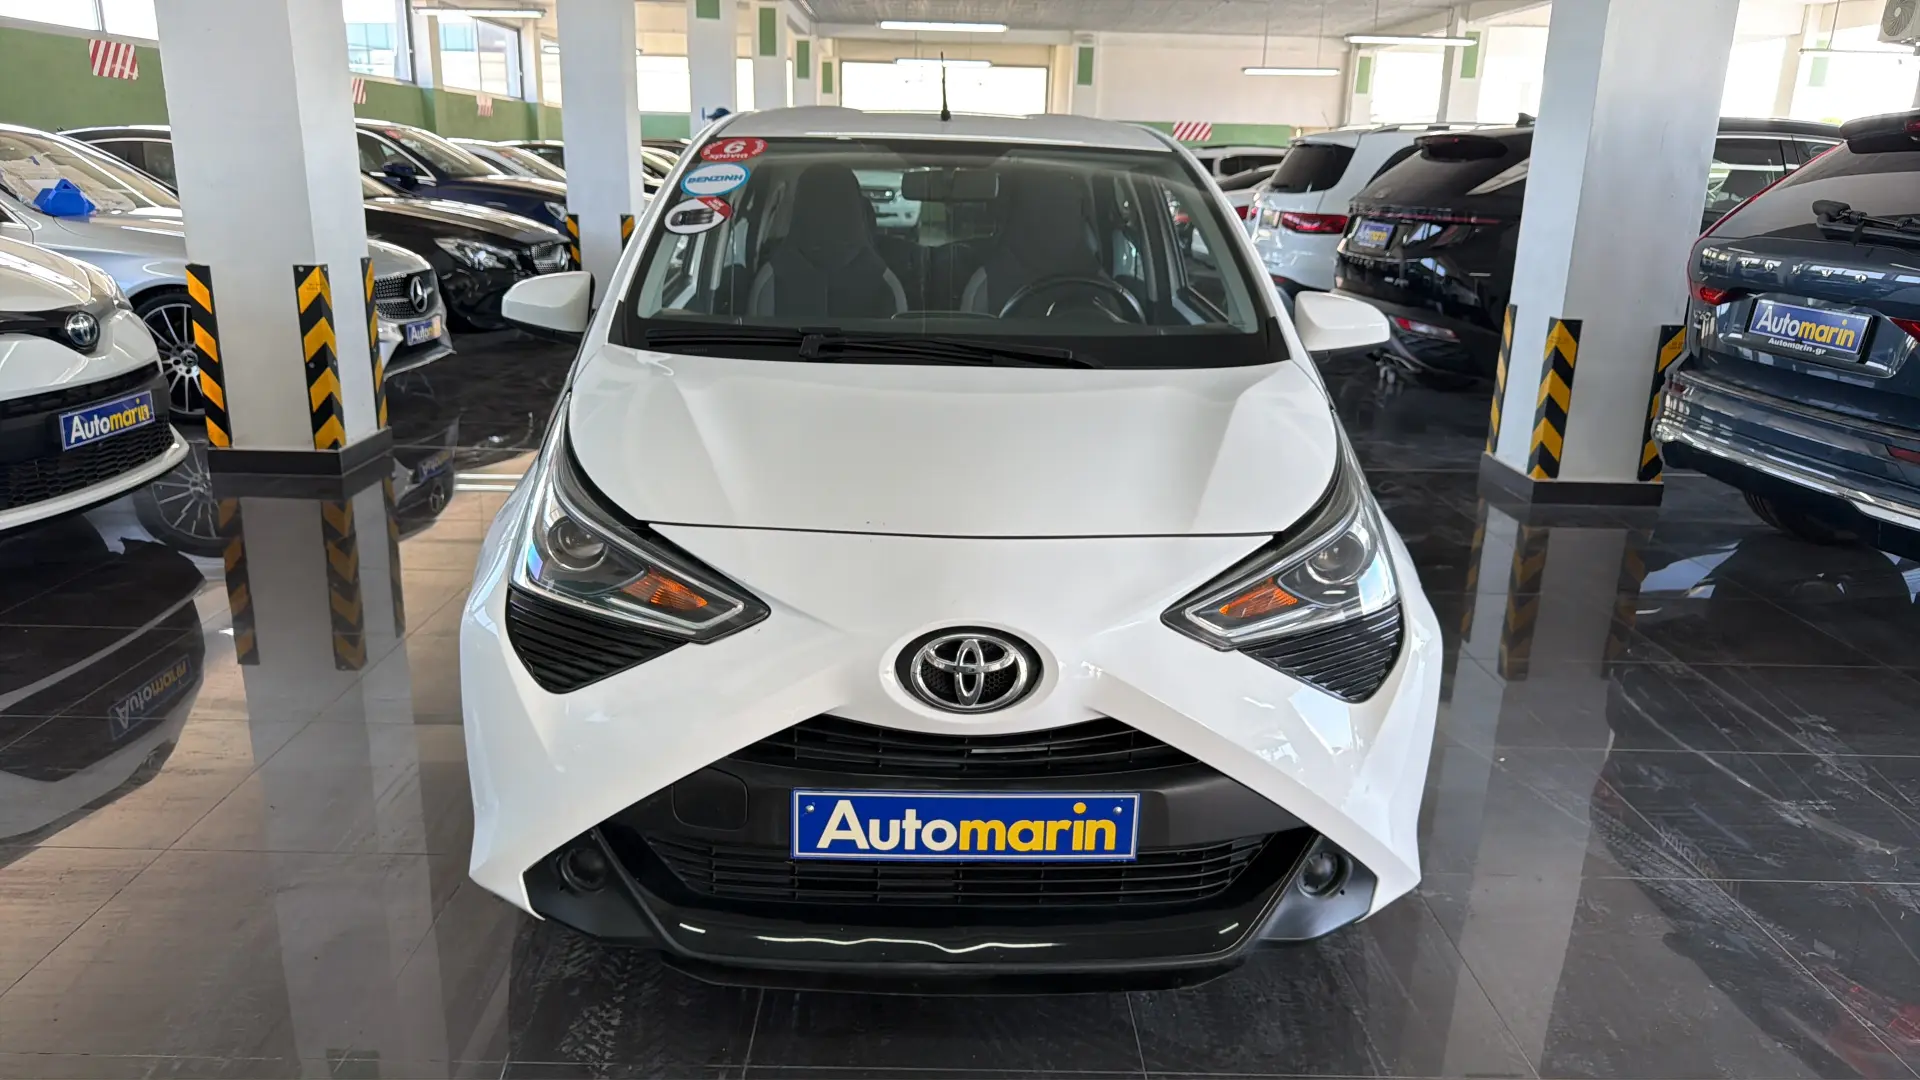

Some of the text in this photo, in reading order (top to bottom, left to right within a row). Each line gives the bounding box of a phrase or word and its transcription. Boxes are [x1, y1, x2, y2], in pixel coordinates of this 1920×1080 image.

[724, 140, 747, 154] 6
[1756, 305, 1856, 348] Automarin
[1768, 337, 1827, 356] Automarin.gr
[70, 397, 150, 444] Automarin
[816, 800, 1117, 852] Automarin
